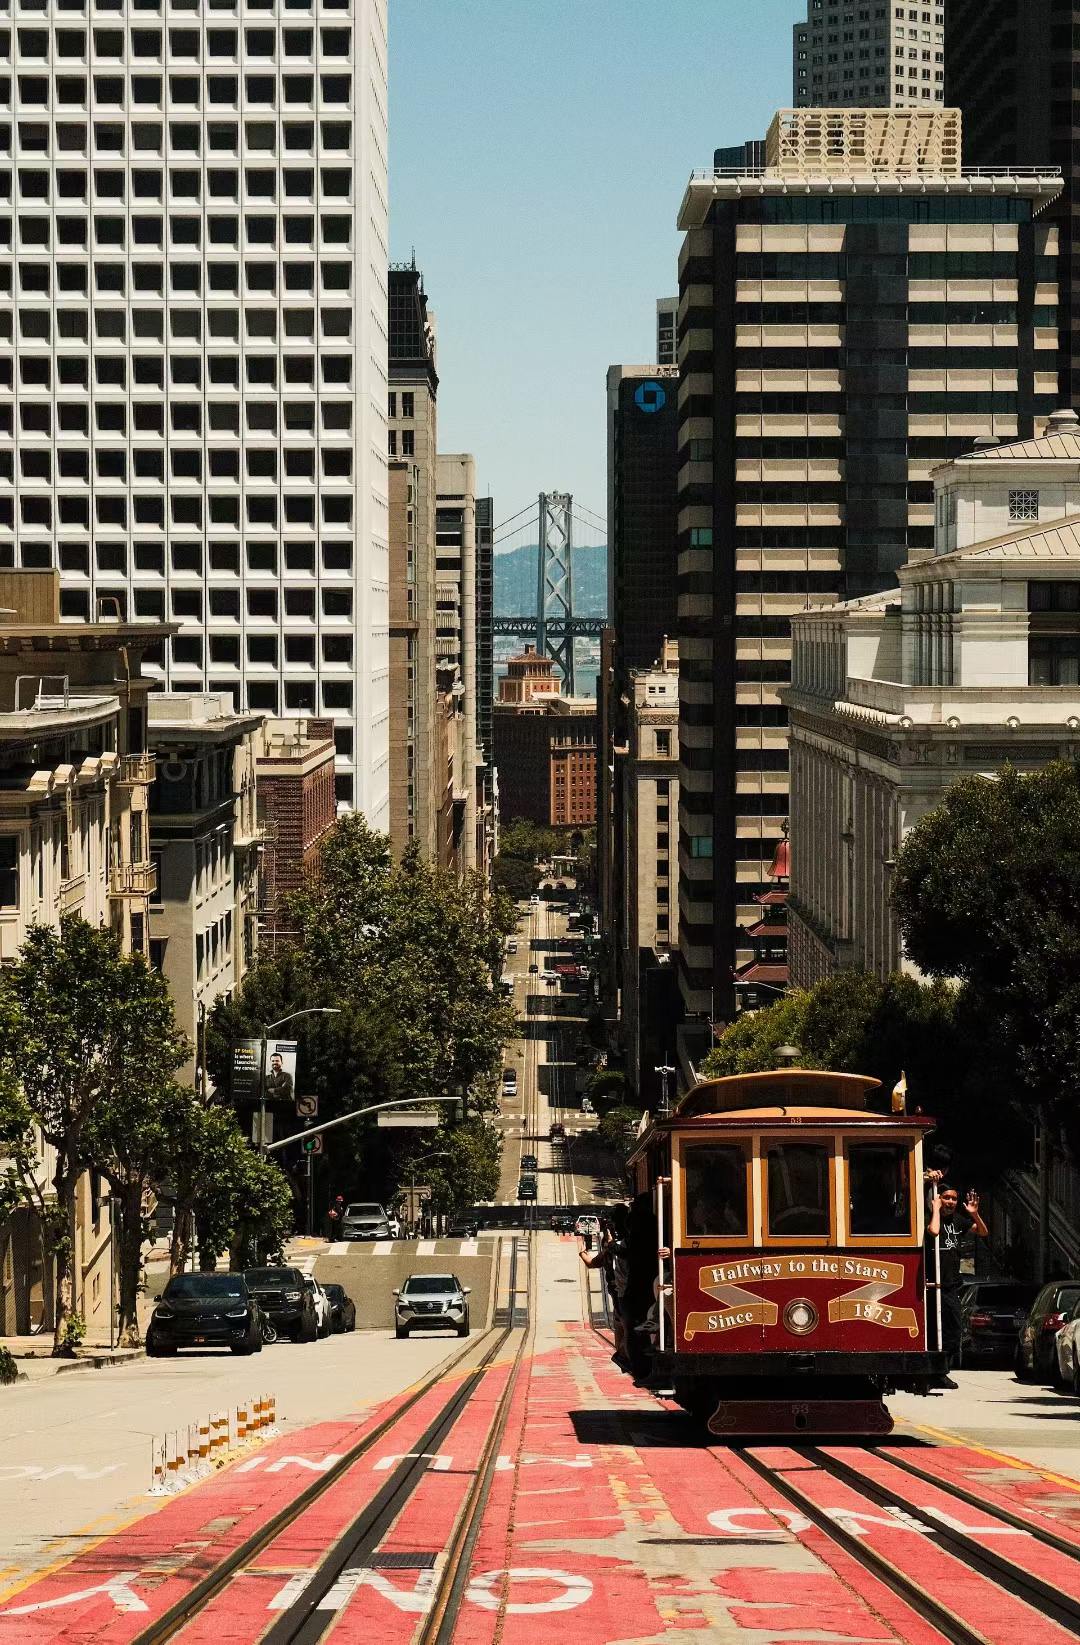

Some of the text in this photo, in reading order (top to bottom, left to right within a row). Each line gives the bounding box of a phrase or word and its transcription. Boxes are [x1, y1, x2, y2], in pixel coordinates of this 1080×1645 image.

[712, 1259, 889, 1283] Halfway to the Stars
[707, 1311, 754, 1330] Since
[854, 1304, 893, 1323] 1873
[706, 1506, 1057, 1536] ONL
